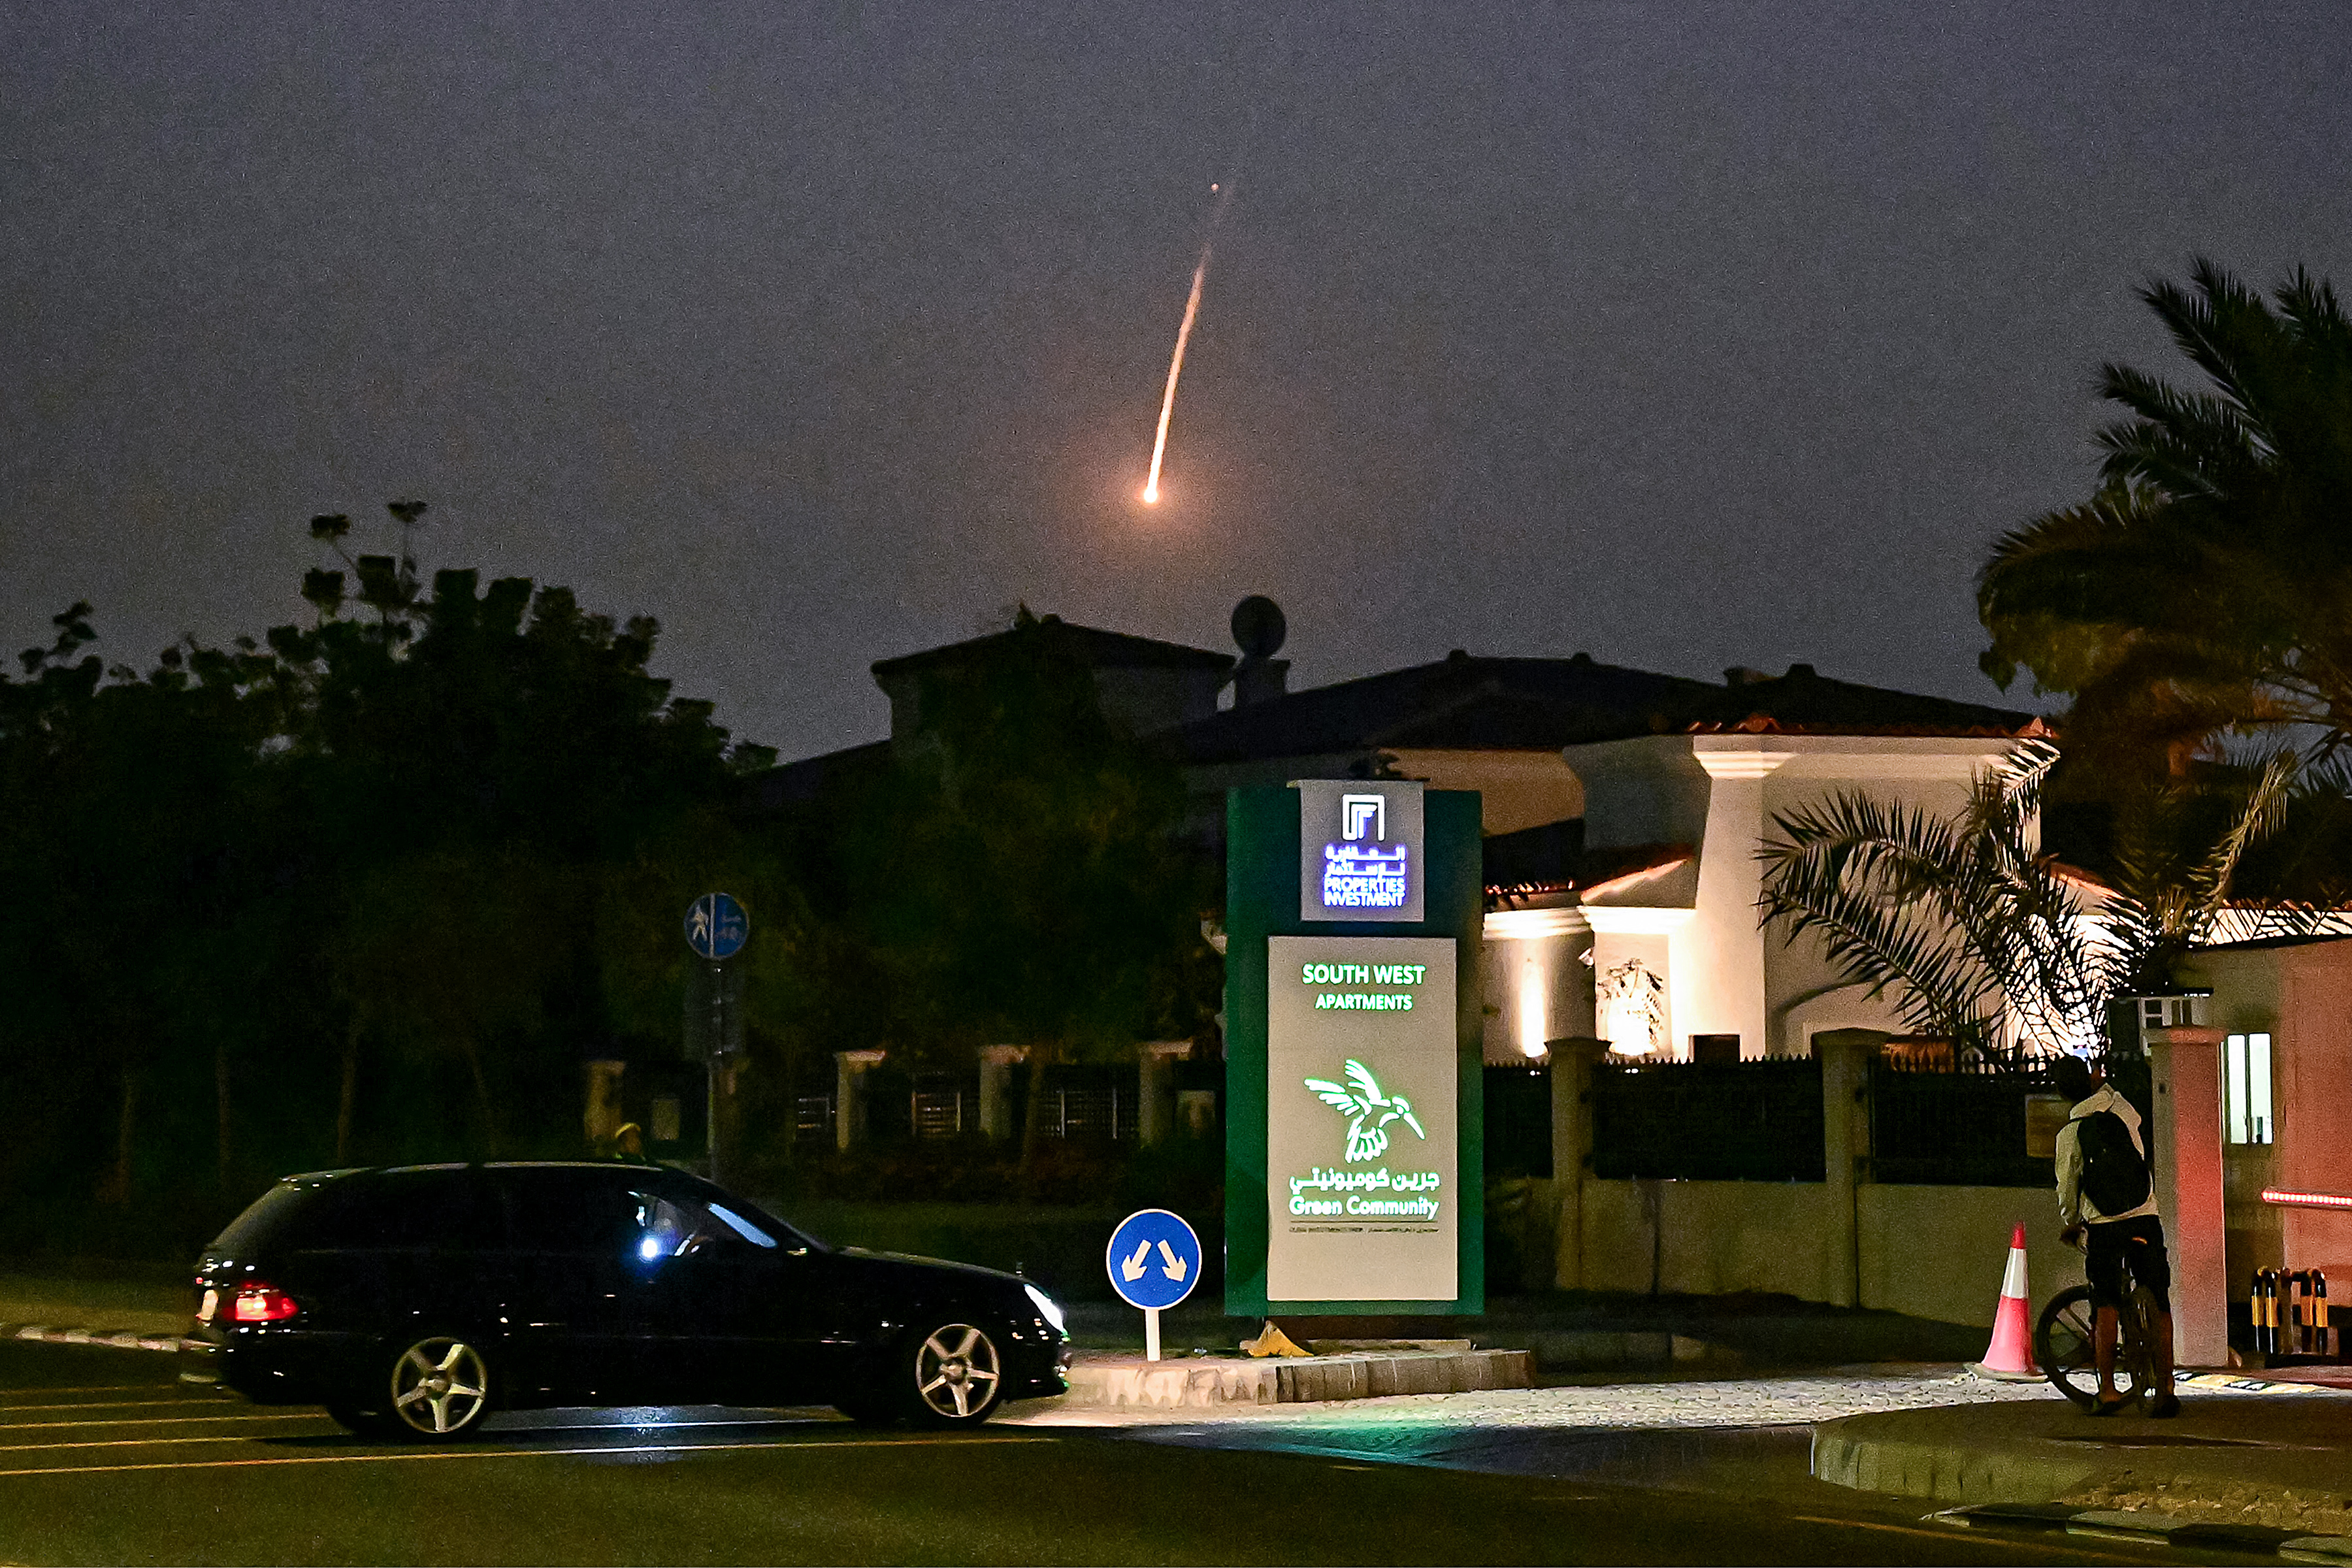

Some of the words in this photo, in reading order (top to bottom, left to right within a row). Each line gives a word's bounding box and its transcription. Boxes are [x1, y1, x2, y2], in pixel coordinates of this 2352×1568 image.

[1324, 877, 1405, 892] PROPERTIES
[1324, 892, 1405, 907] INVESTMENT
[1302, 964, 1369, 985] SOUTH
[1373, 964, 1426, 985] WEST
[1315, 994, 1413, 1011] APARTMENTS
[1289, 1167, 1390, 1195] كوميونيتي
[1392, 1172, 1440, 1192] جرين
[1289, 1196, 1343, 1215] Green
[1346, 1195, 1439, 1220] Community
